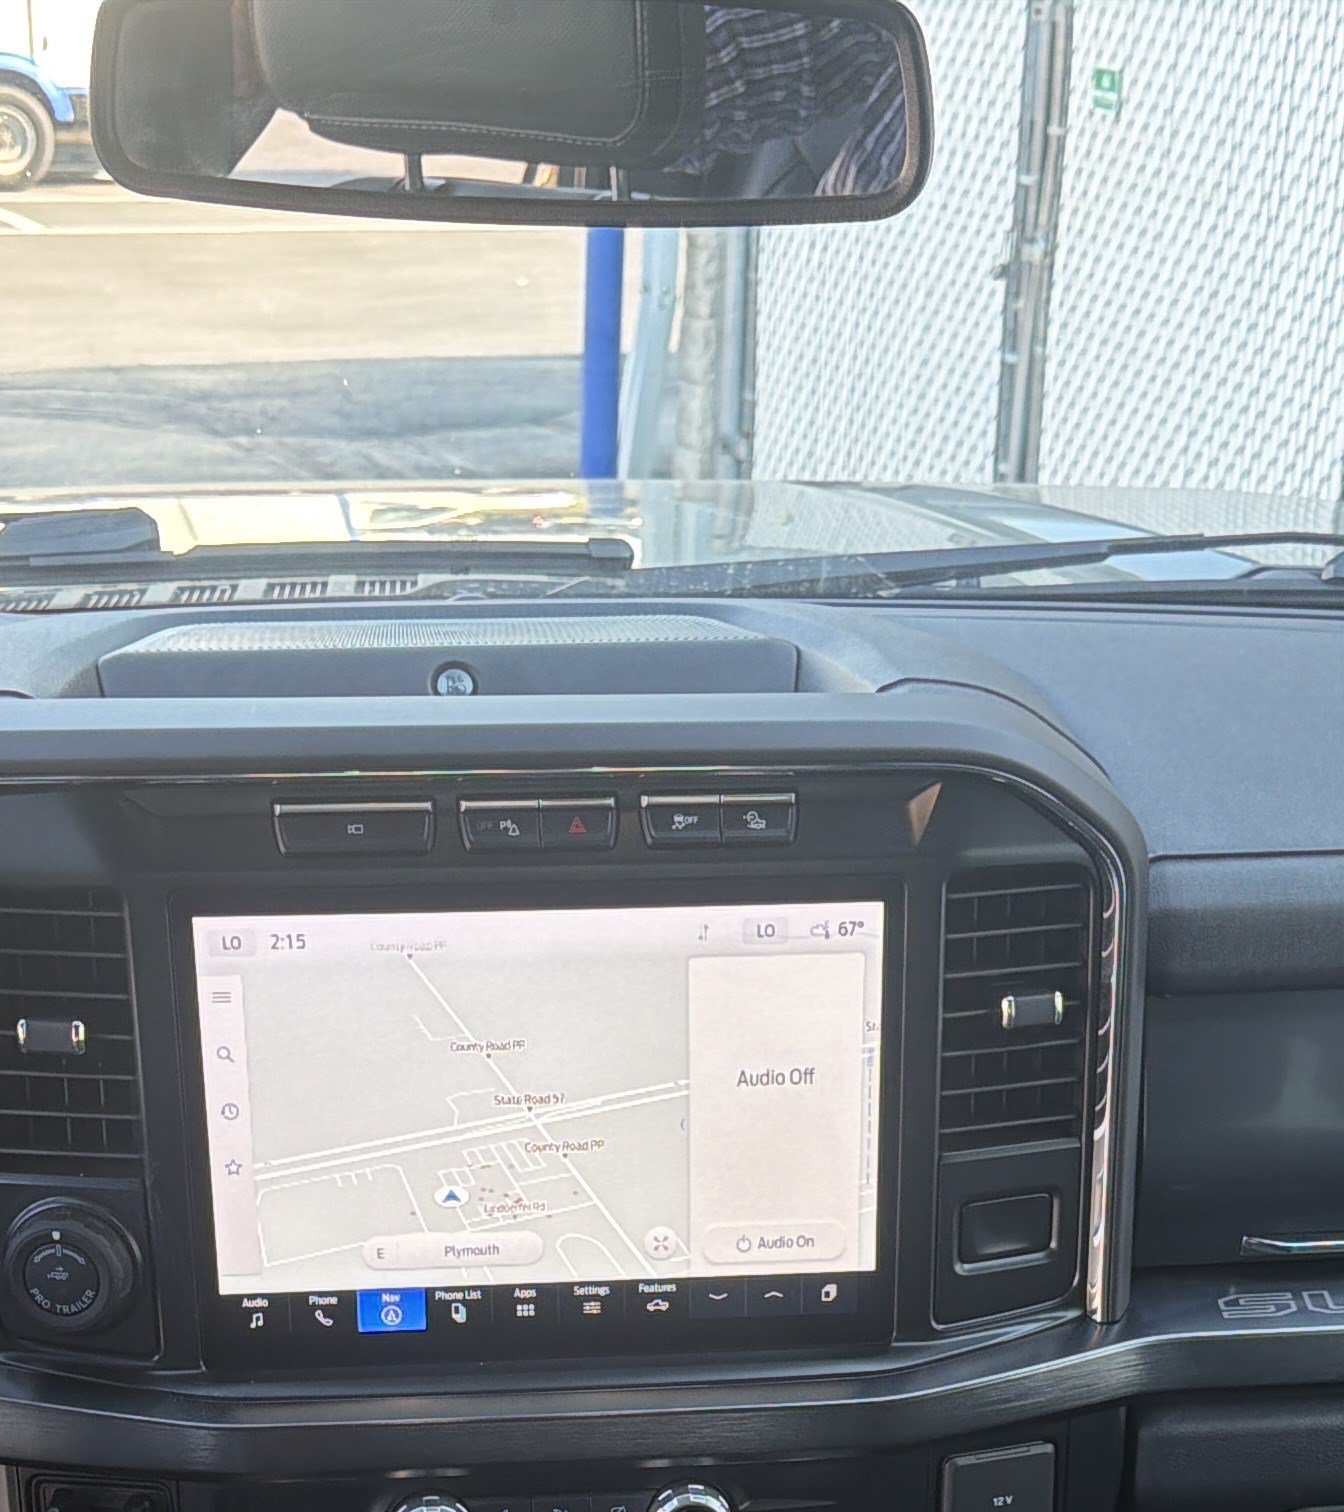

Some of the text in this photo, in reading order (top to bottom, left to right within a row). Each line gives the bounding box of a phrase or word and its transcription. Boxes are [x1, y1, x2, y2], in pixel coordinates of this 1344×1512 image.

[685, 816, 698, 825] OFF
[756, 924, 776, 938] LO
[838, 920, 865, 937] 67°
[221, 935, 242, 950] LO
[270, 934, 306, 950] 2:15
[450, 1041, 485, 1053] County
[486, 1040, 511, 1050] Road
[736, 1067, 816, 1087] Audio Off
[494, 1095, 522, 1105] State
[524, 1094, 551, 1105] Road
[524, 1140, 604, 1153] County Road PP
[757, 1235, 815, 1250] Audio On
[376, 1247, 385, 1259] E
[444, 1244, 500, 1259] Plymouth
[513, 1287, 537, 1299] Apps
[573, 1285, 610, 1297] Settings
[638, 1282, 677, 1294] Features
[30, 1288, 96, 1314] PRO TRAILER
[309, 1295, 338, 1306] Phone
[381, 1292, 400, 1303] Nav
[435, 1289, 482, 1301] Phone List
[242, 1297, 269, 1308] Audio
